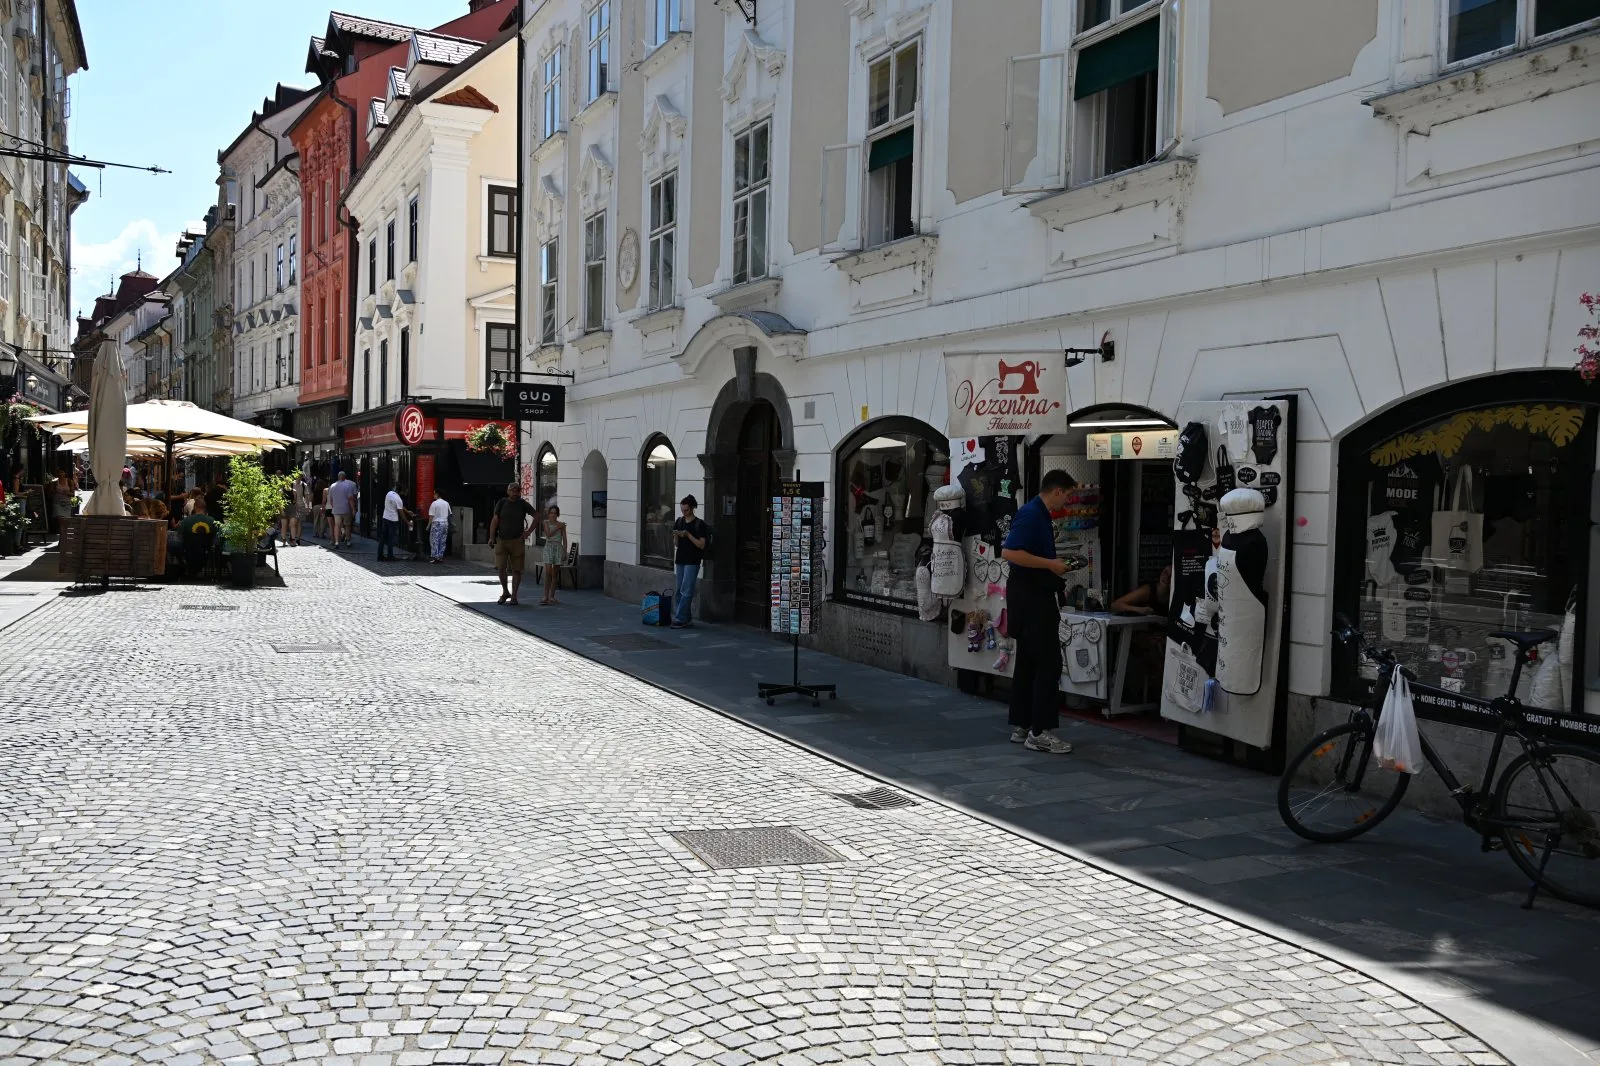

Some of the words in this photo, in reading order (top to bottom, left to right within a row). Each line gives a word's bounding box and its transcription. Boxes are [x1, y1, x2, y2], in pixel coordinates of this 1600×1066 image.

[519, 391, 551, 402] GUD
[955, 378, 1060, 416] Vezenina
[987, 418, 1033, 431] Handmade
[1256, 419, 1274, 430] DIAPER
[1386, 487, 1419, 500] MODE
[1420, 694, 1437, 705] NOME
[1436, 695, 1457, 709] GRATIS
[1461, 702, 1478, 713] NAME
[1526, 713, 1553, 726] GRATUIT
[1560, 718, 1588, 732] NOMBRE
